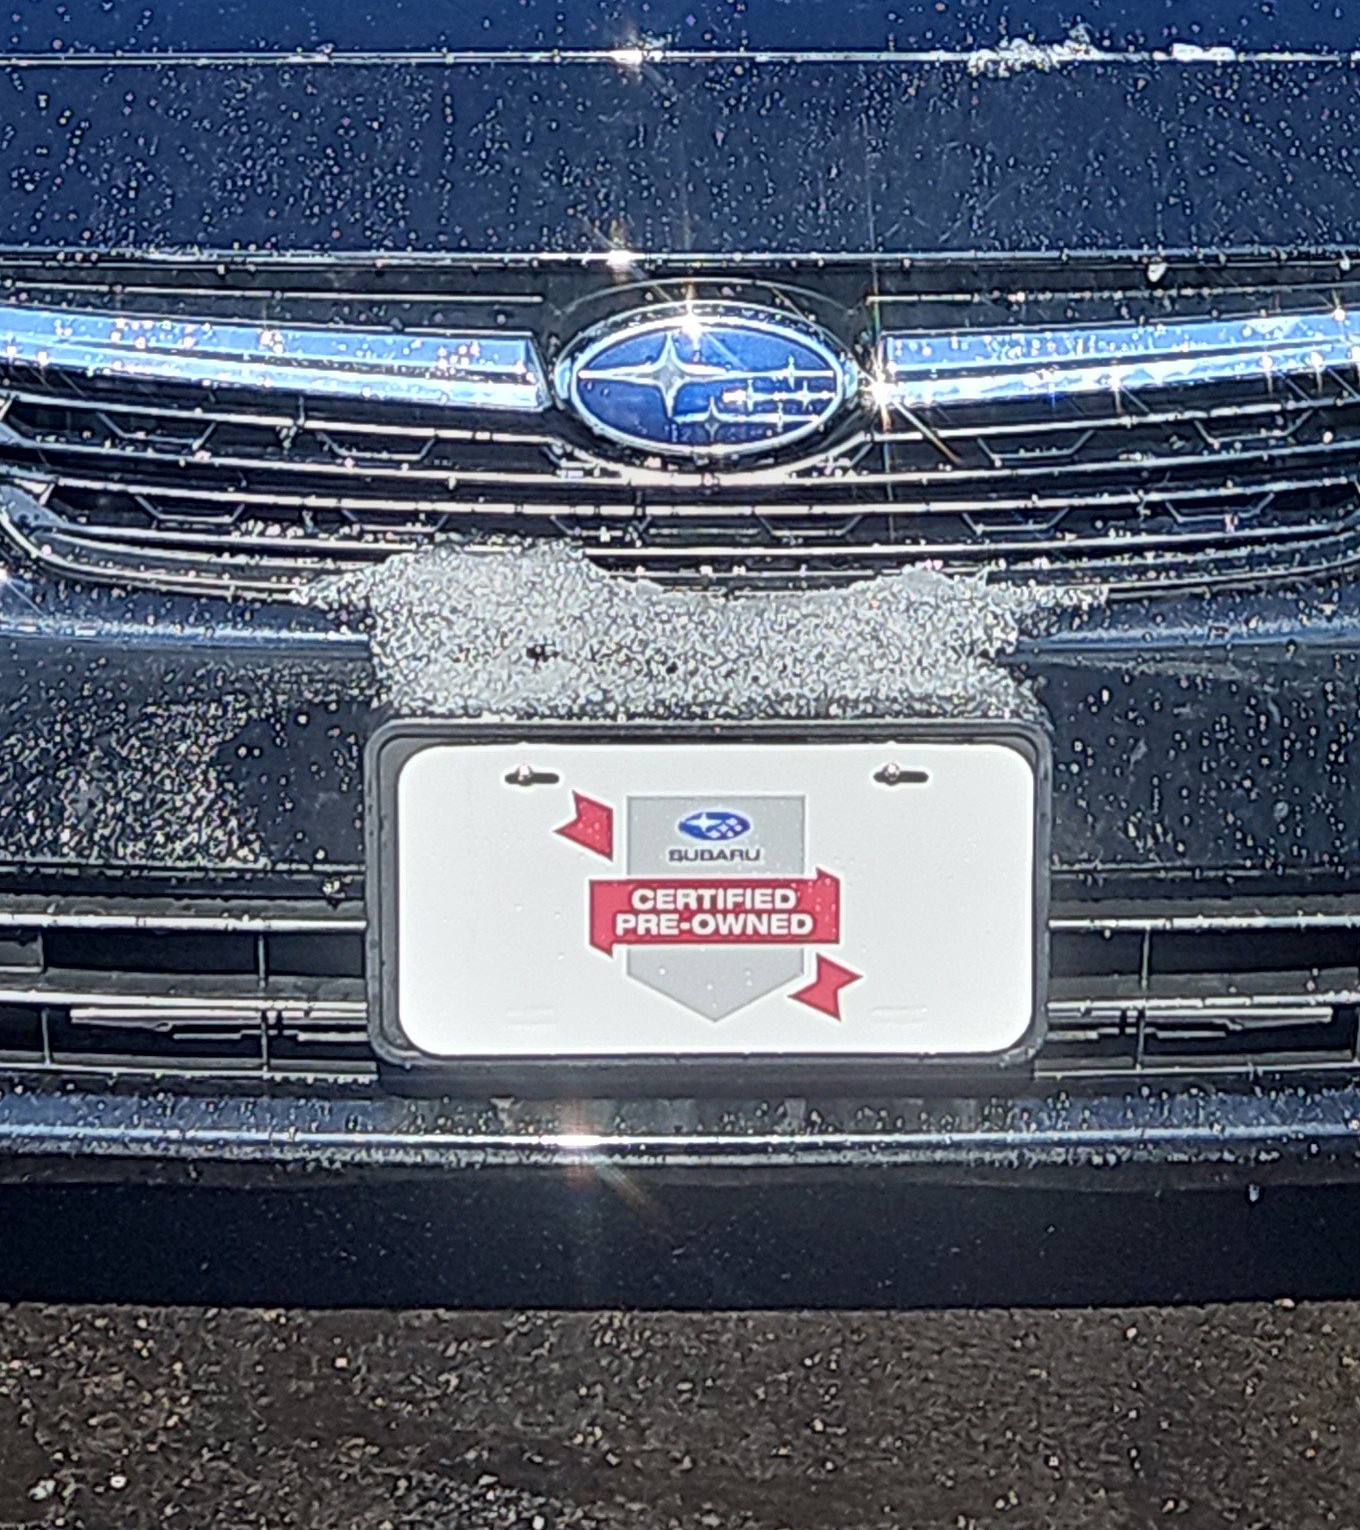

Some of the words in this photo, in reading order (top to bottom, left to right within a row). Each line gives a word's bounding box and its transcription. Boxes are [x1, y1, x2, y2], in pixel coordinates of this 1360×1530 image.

[668, 848, 761, 862] SUBARU
[631, 887, 797, 911] CERTIFIED
[615, 912, 814, 936] PRE-OWNED
